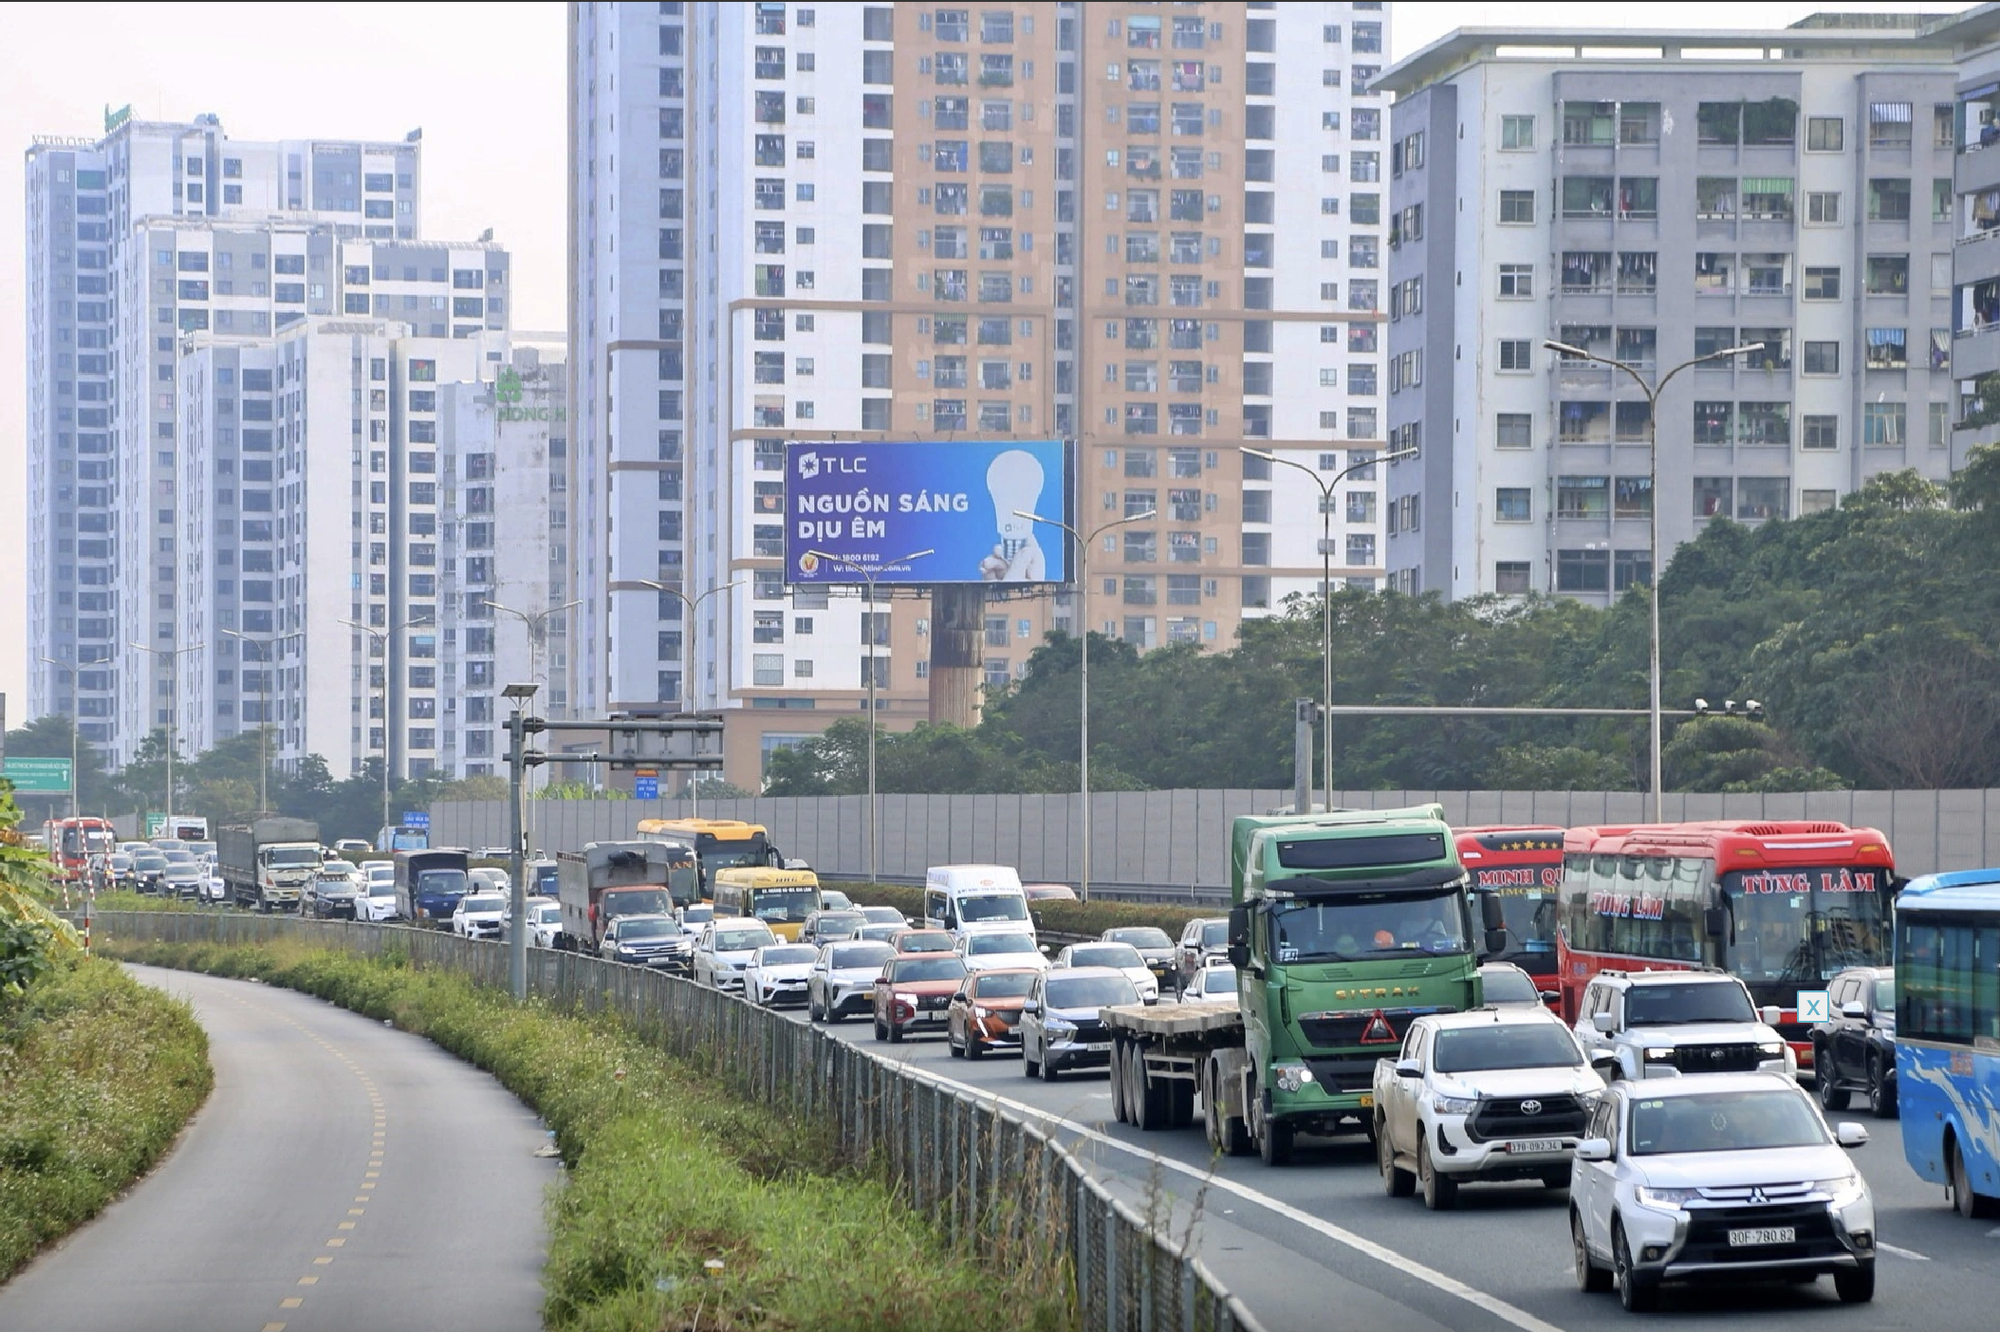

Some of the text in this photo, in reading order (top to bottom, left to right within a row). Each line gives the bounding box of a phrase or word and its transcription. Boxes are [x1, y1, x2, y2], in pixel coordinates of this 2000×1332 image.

[823, 457, 867, 473] TLC
[798, 487, 969, 513] NGUỒN SÁNG
[798, 516, 885, 542] DỊU ÊM
[1478, 868, 1535, 886] MINH
[1742, 868, 1875, 894] TÙNG LÂM
[1593, 889, 1665, 921] TÙNG LÂM
[1335, 986, 1420, 1000] SITRAK
[1730, 1228, 1794, 1245] 30F-780.82
